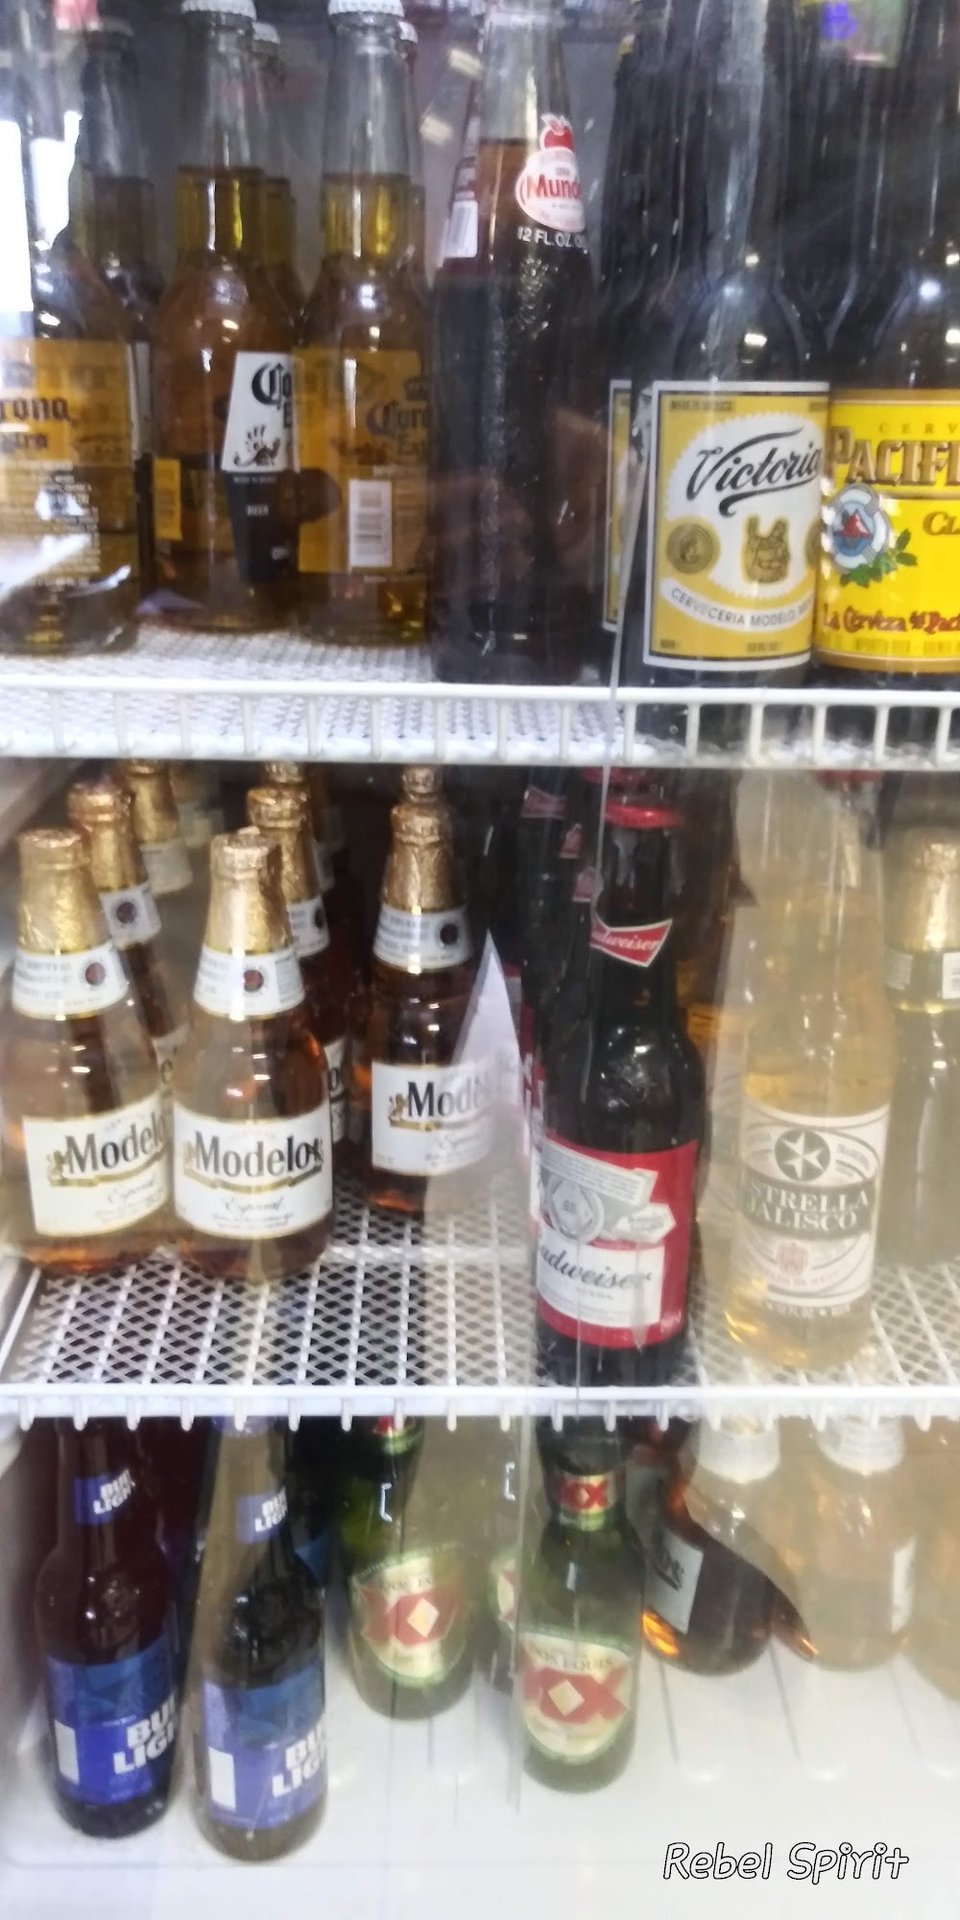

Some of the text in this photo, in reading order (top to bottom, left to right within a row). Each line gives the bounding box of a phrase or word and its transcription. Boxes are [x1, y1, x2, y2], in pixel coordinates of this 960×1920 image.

[517, 226, 532, 241] 12
[685, 426, 822, 503] Victoria
[750, 608, 796, 627] MODELO
[194, 1130, 312, 1178] Modelo
[748, 1177, 869, 1214] STRELLA
